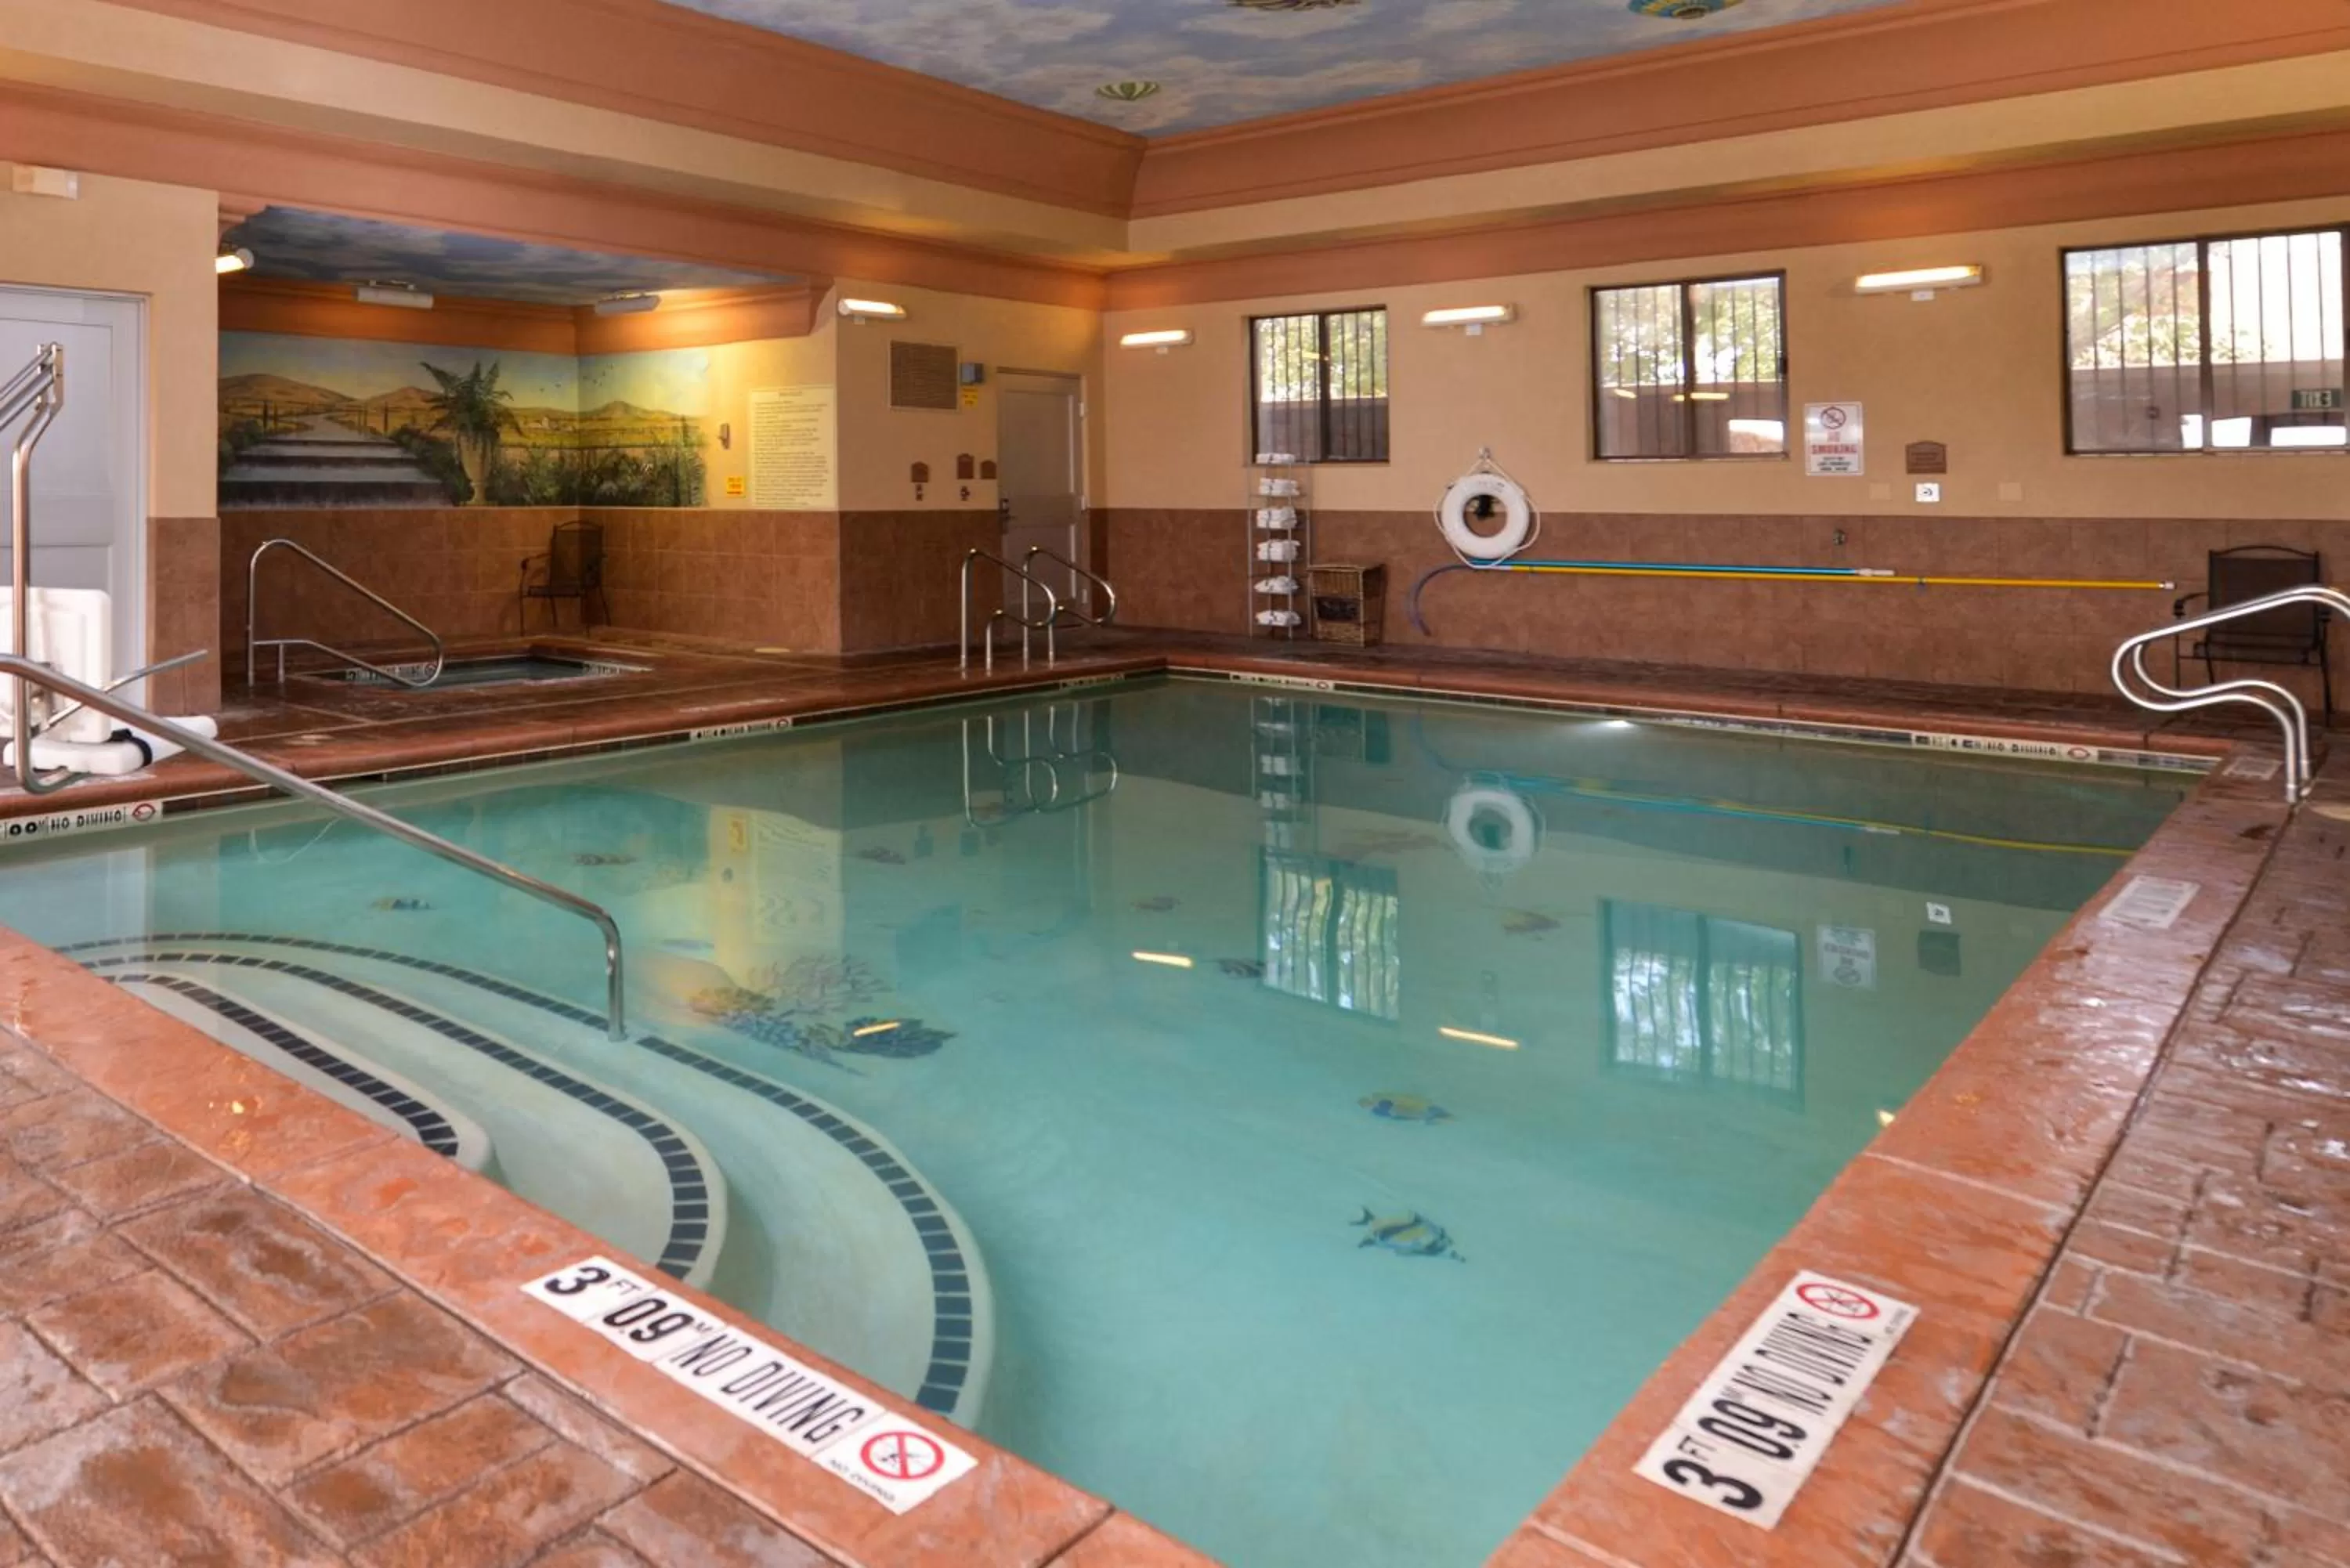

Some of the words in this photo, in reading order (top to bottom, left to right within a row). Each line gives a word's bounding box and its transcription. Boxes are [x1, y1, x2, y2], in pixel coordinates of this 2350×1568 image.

[1812, 444, 1857, 454] SMOKING
[543, 1266, 610, 1295] 3
[1753, 1310, 1873, 1387] DIVING
[671, 1334, 753, 1378] NO
[719, 1360, 865, 1443] DIVING
[1730, 1364, 1834, 1417] NO
[1662, 1458, 1763, 1511] 3
